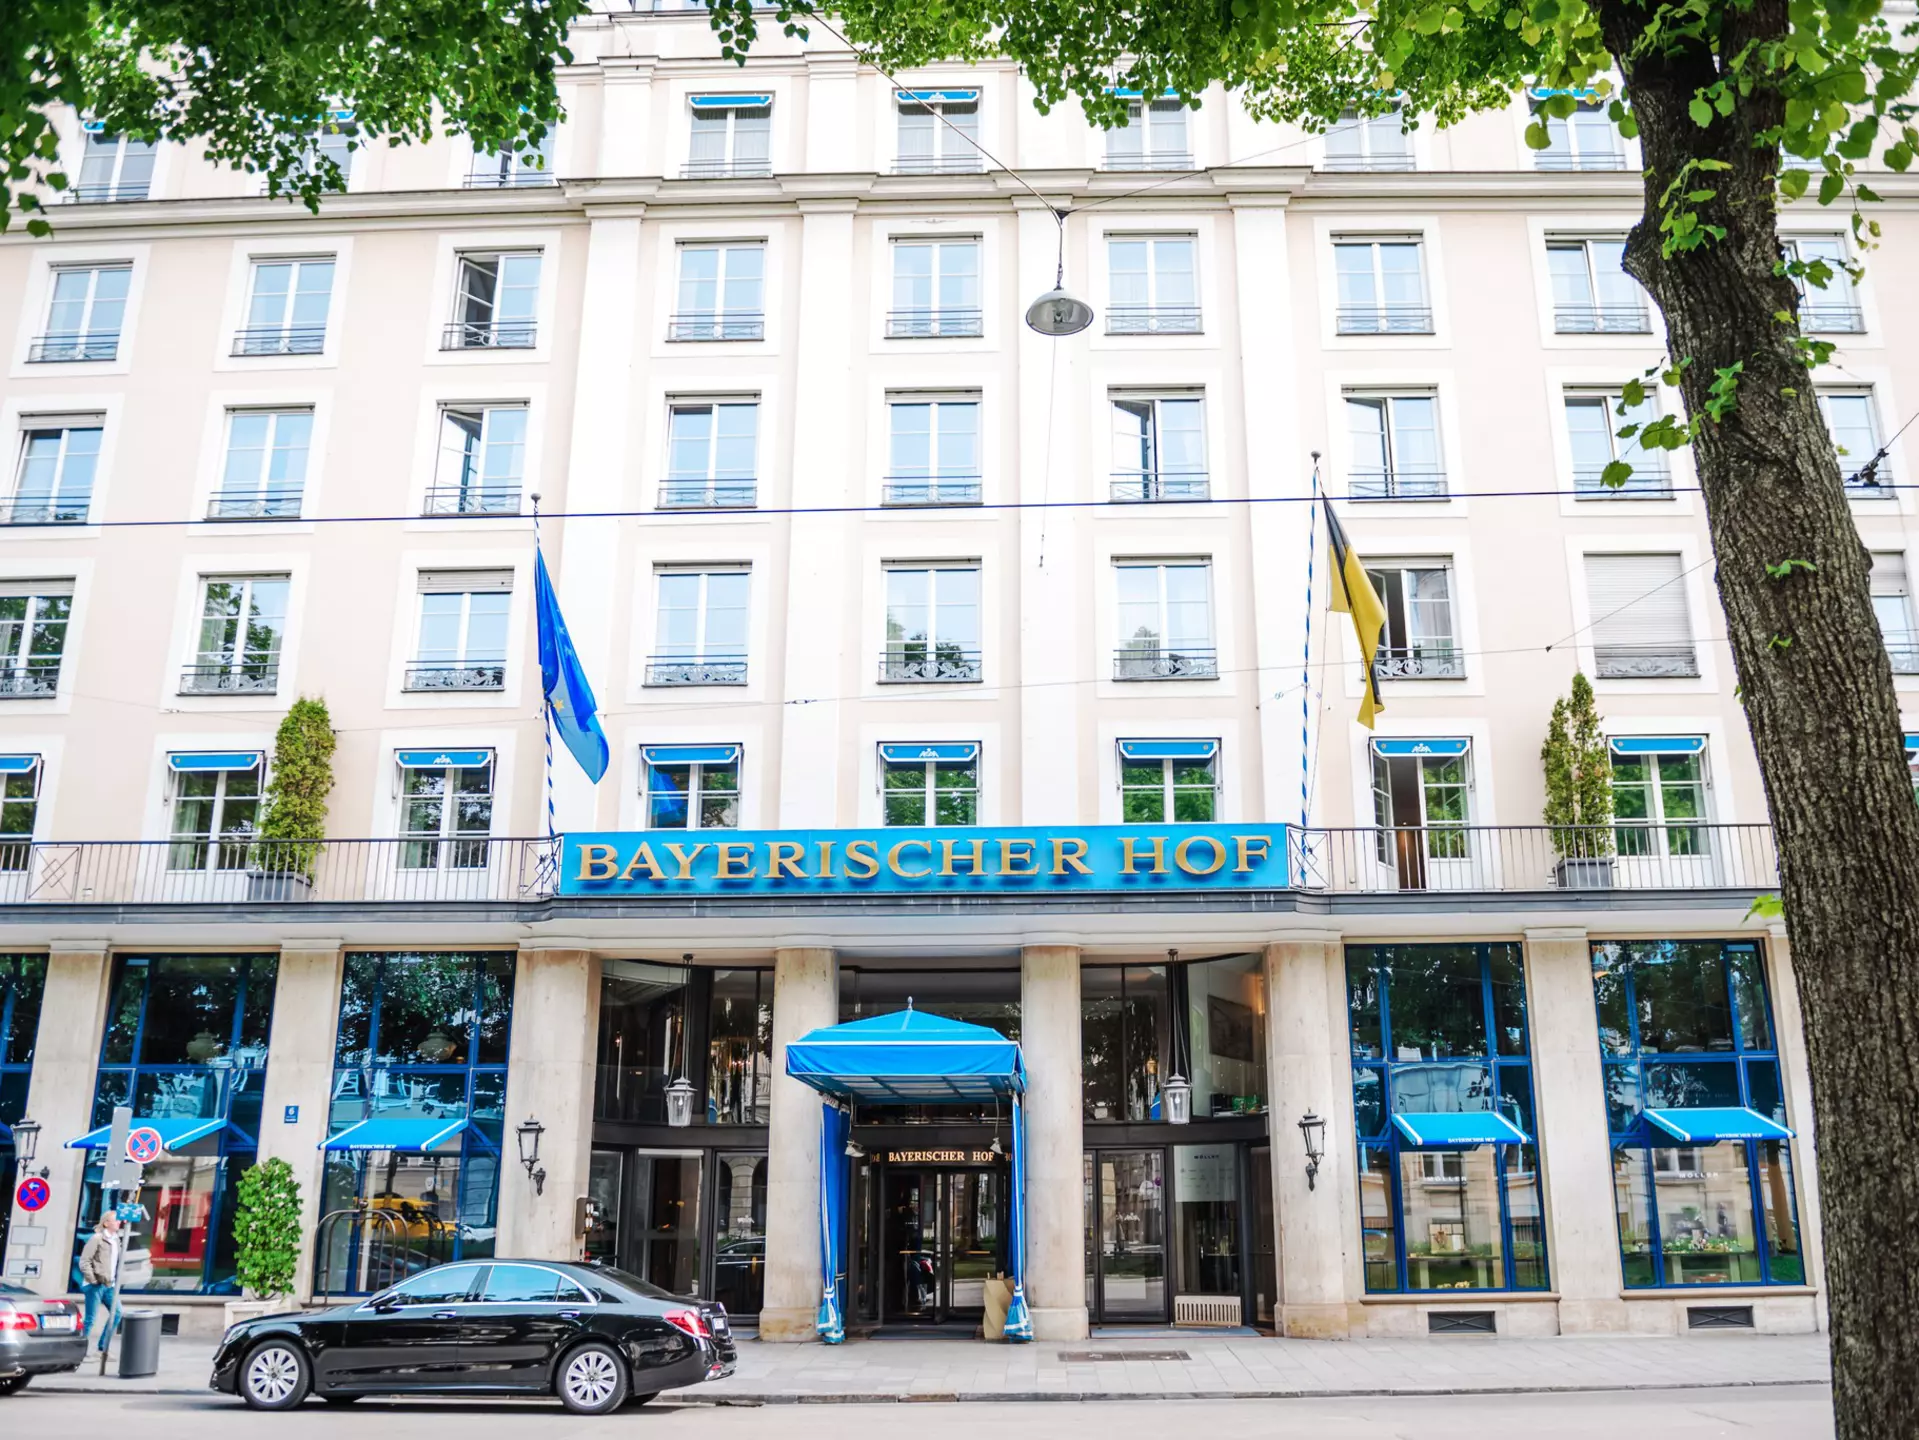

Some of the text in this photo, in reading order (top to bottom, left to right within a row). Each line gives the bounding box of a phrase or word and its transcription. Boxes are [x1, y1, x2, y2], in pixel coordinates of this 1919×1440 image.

[574, 835, 1272, 881] BAYERISCHER HOF
[888, 1150, 965, 1162] BAYERISCHER
[972, 1151, 995, 1162] HOF
